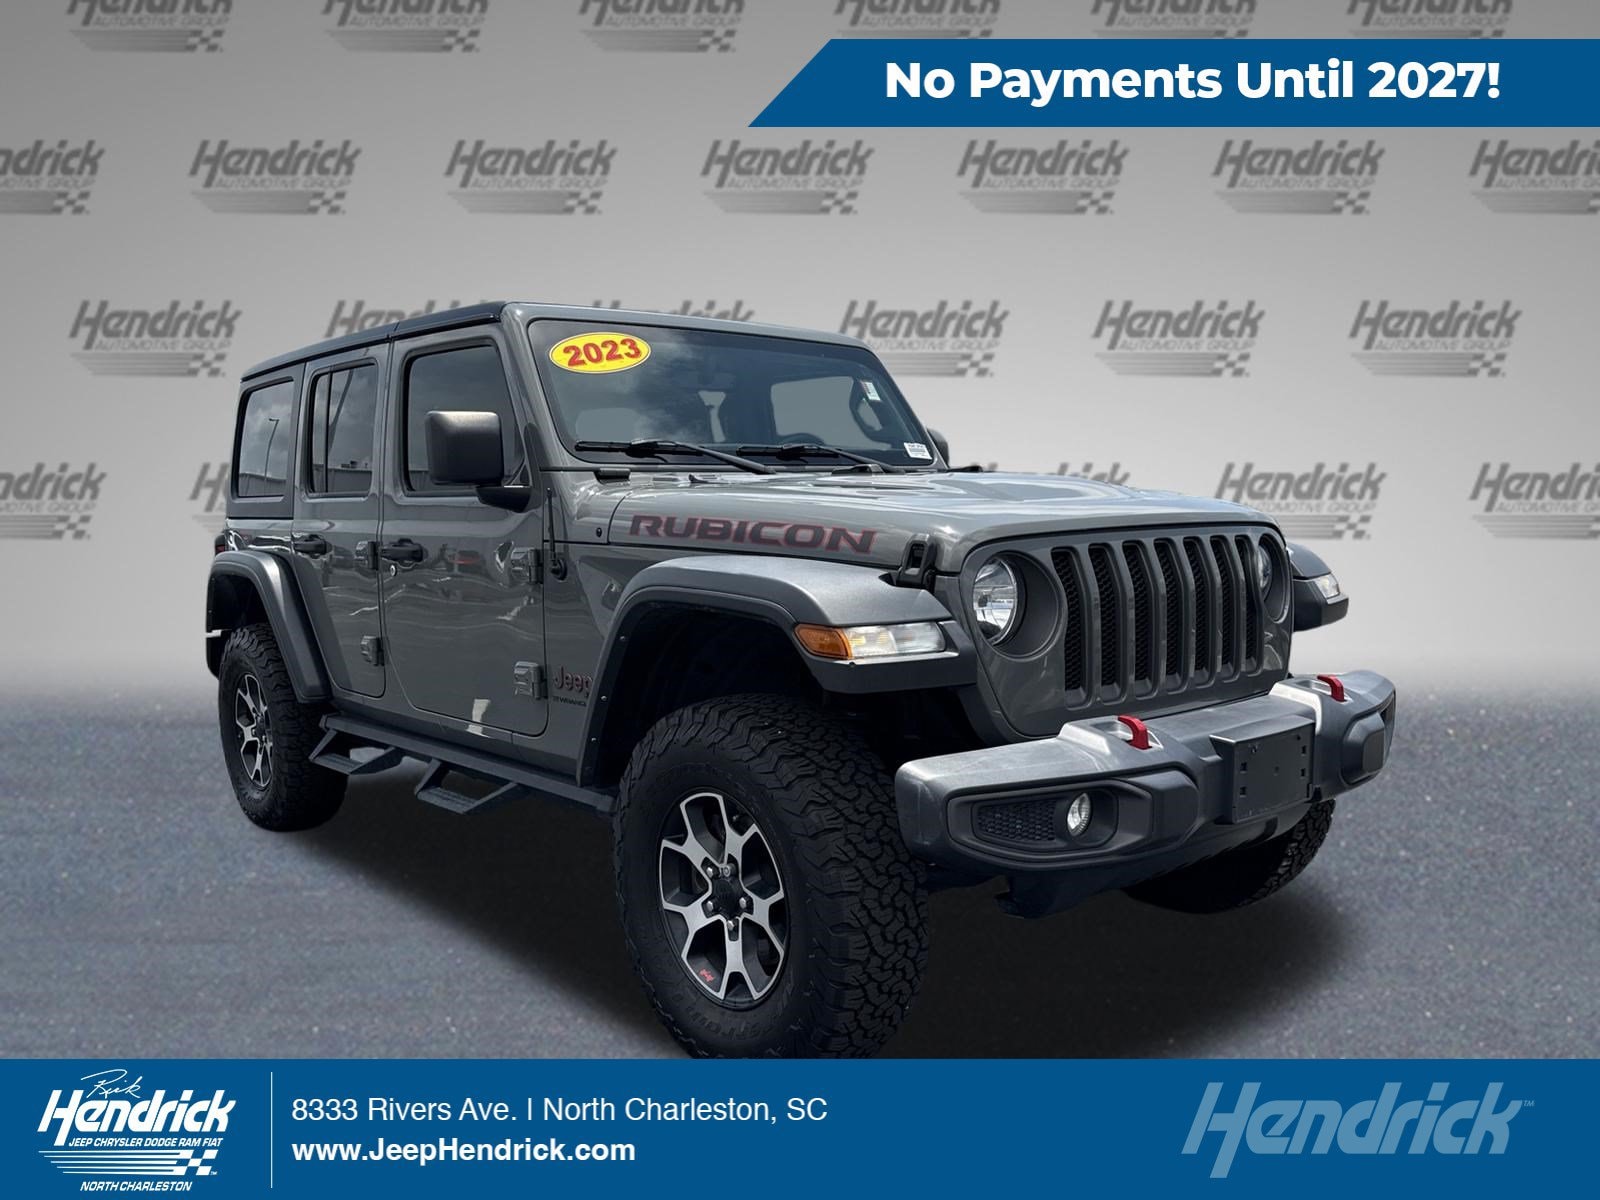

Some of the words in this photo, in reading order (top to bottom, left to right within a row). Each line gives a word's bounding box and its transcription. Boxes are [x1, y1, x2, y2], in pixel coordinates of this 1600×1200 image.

[188, 139, 361, 188] Hendrick
[444, 139, 617, 188] Hendrick
[700, 139, 873, 188] Hendrick
[956, 139, 1129, 188] Hendrick
[1212, 139, 1385, 188] Hendrick
[1468, 139, 1600, 188] Hendri
[69, 300, 242, 350] Hendrick
[1092, 300, 1265, 350] Hendrick
[1348, 300, 1522, 350] Hendrick
[563, 338, 641, 367] 2023
[1214, 463, 1387, 502] Hendrick
[1470, 463, 1600, 512] Hendri
[629, 515, 877, 554] RUBICON
